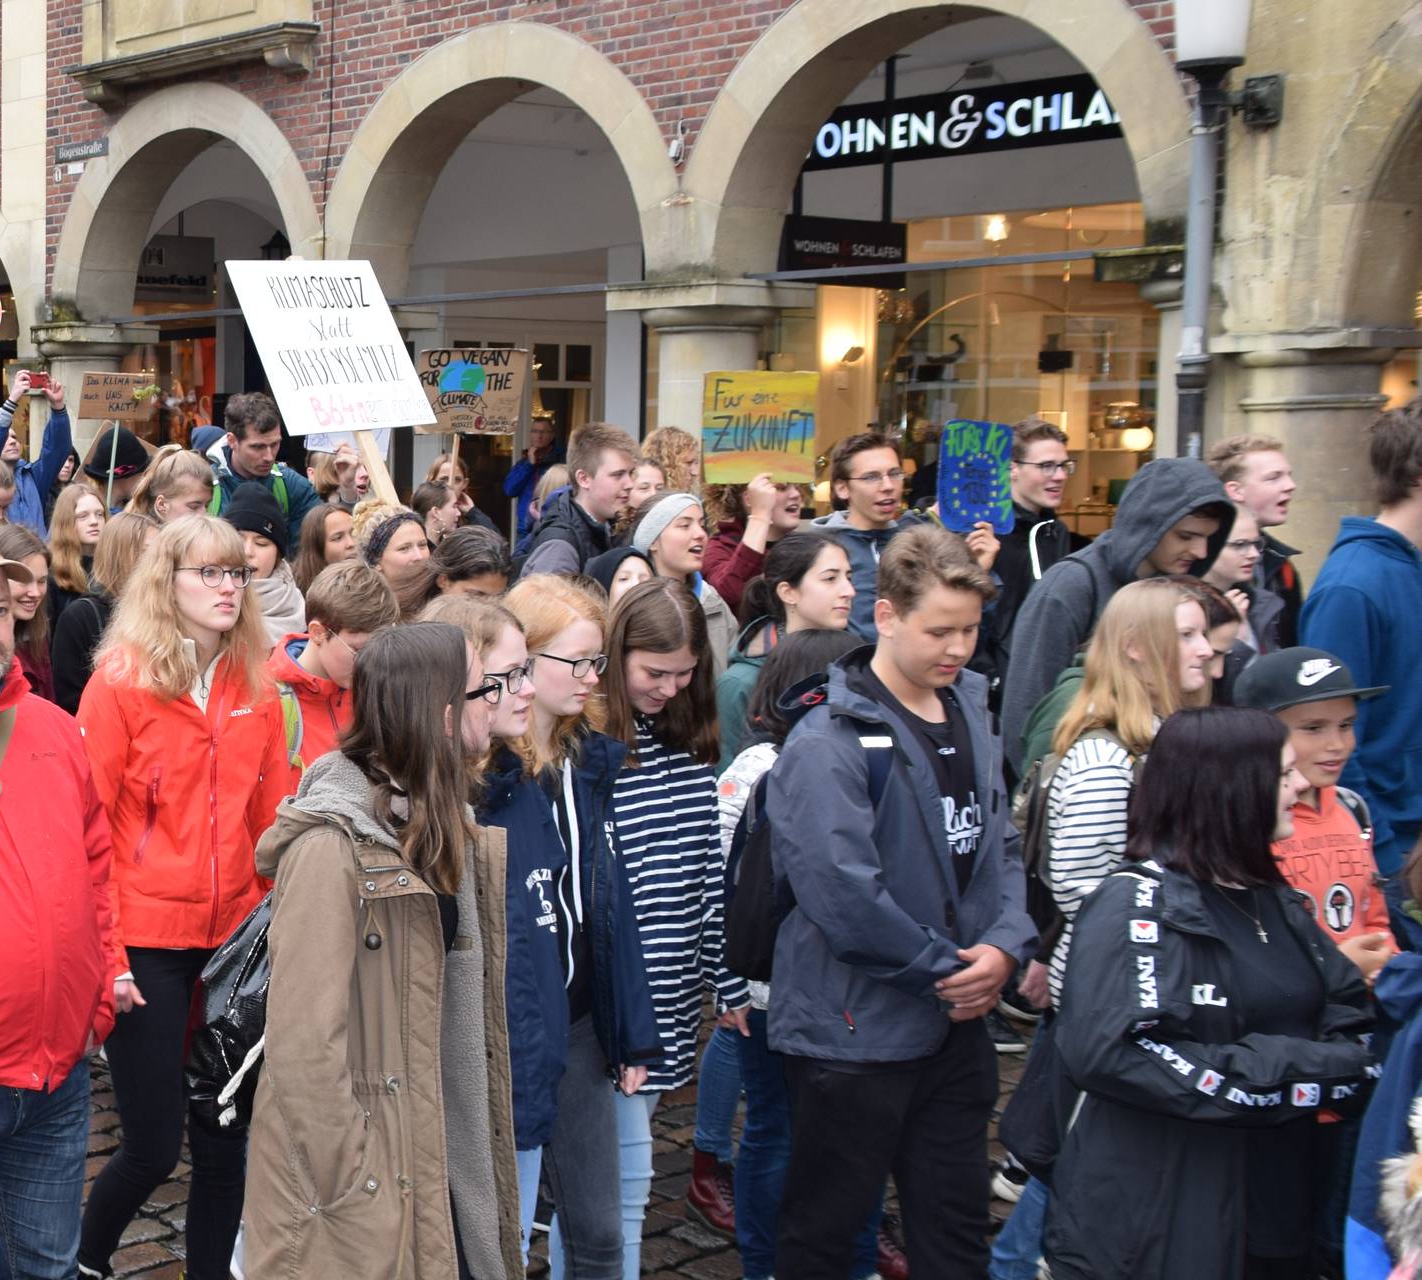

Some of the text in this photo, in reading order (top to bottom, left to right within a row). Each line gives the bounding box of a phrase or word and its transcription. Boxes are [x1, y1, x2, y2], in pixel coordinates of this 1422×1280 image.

[807, 89, 1121, 159] OHNEN & SCHLA
[59, 141, 103, 159] Bogenstraße
[794, 240, 840, 254] WOHNEN
[852, 244, 902, 258] SCHLAFEN
[266, 276, 371, 309] KLIMASCHUTZ
[428, 350, 511, 368] GO VEGAN
[103, 375, 130, 386] KLIMA
[419, 370, 514, 391] FOR THE
[105, 391, 122, 400] UNS
[441, 394, 477, 406] CLIMATE
[714, 379, 744, 412] Für
[711, 410, 814, 454] ZUKUNFT
[1302, 659, 1332, 674] NIKE
[1277, 852, 1334, 884] ARTY
[1137, 956, 1158, 1008] KANI
[1135, 1037, 1196, 1076] KANI
[1225, 1086, 1282, 1106] KANI
